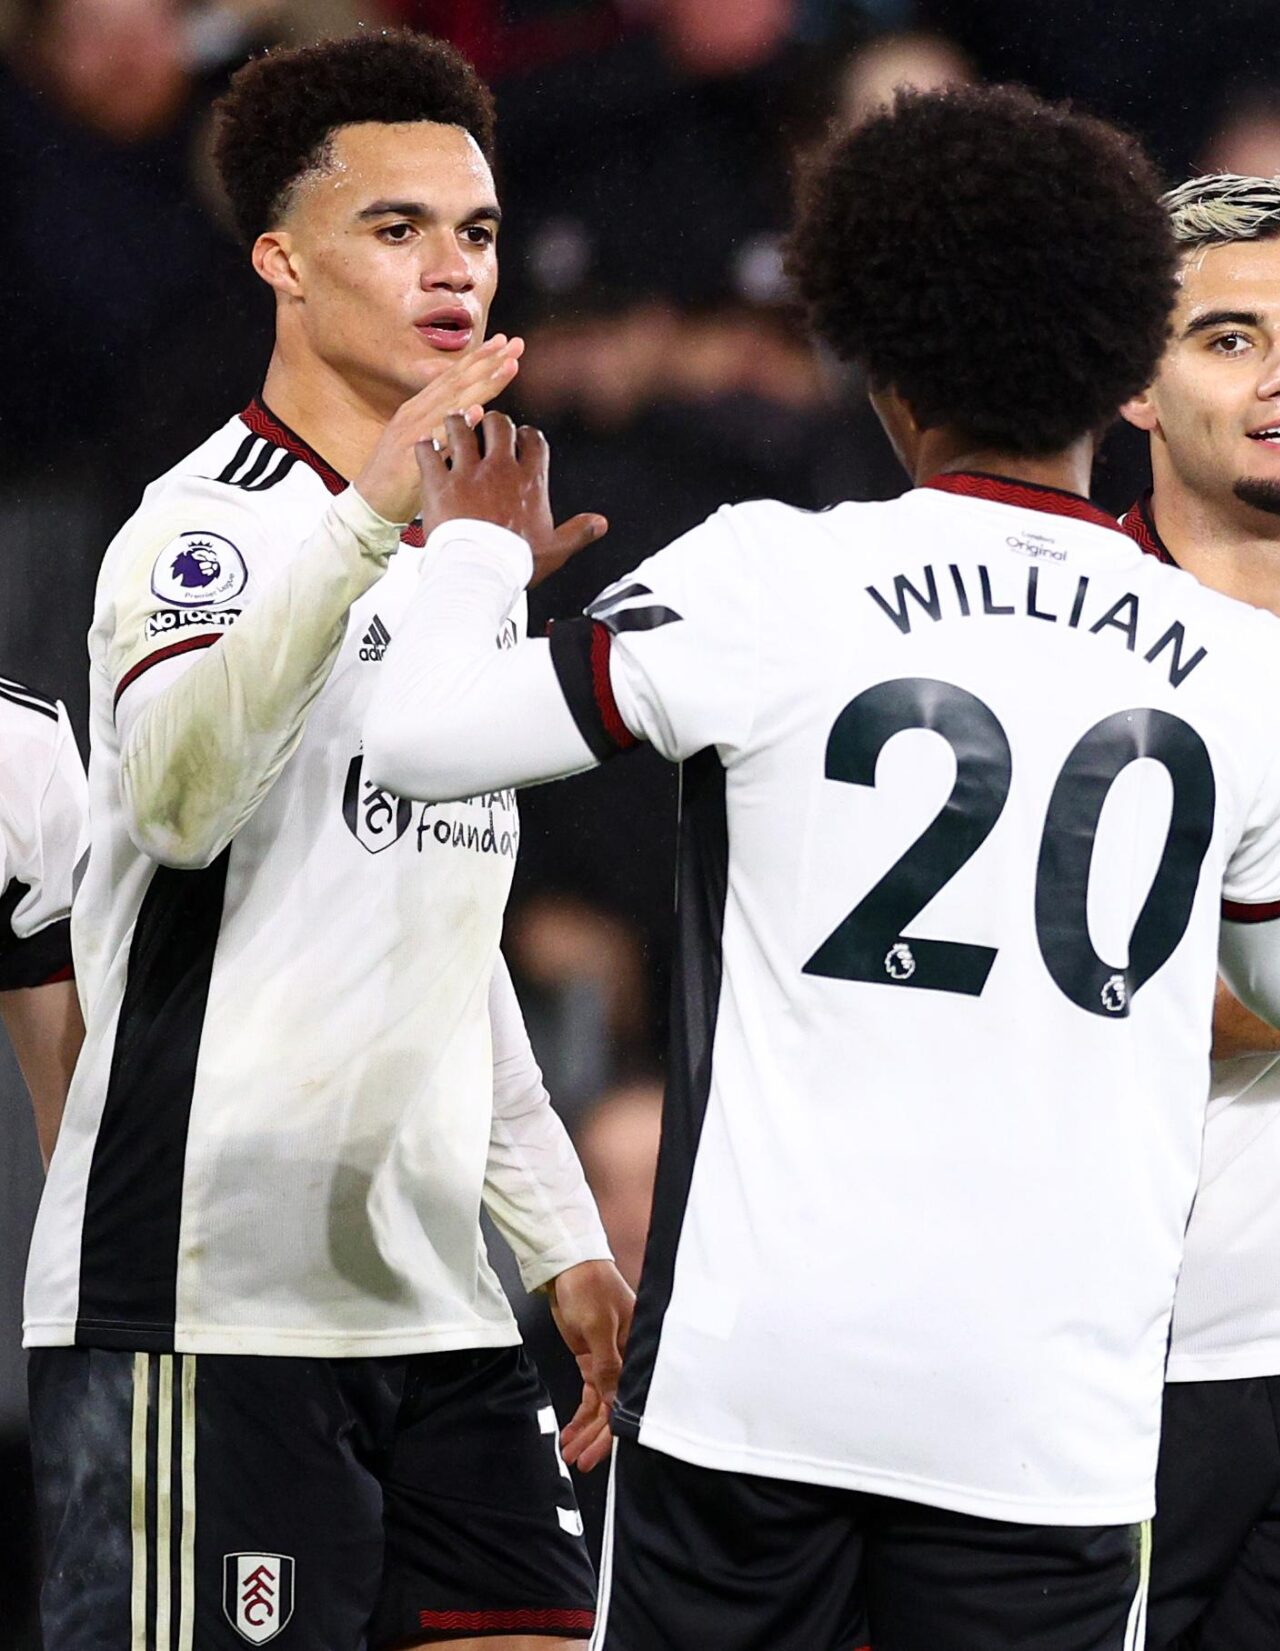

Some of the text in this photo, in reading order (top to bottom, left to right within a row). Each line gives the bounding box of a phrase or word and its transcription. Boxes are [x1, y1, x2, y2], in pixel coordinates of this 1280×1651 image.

[1005, 536, 1067, 561] Original
[865, 563, 1208, 689] WILLIAN
[802, 676, 1217, 1019] 20
